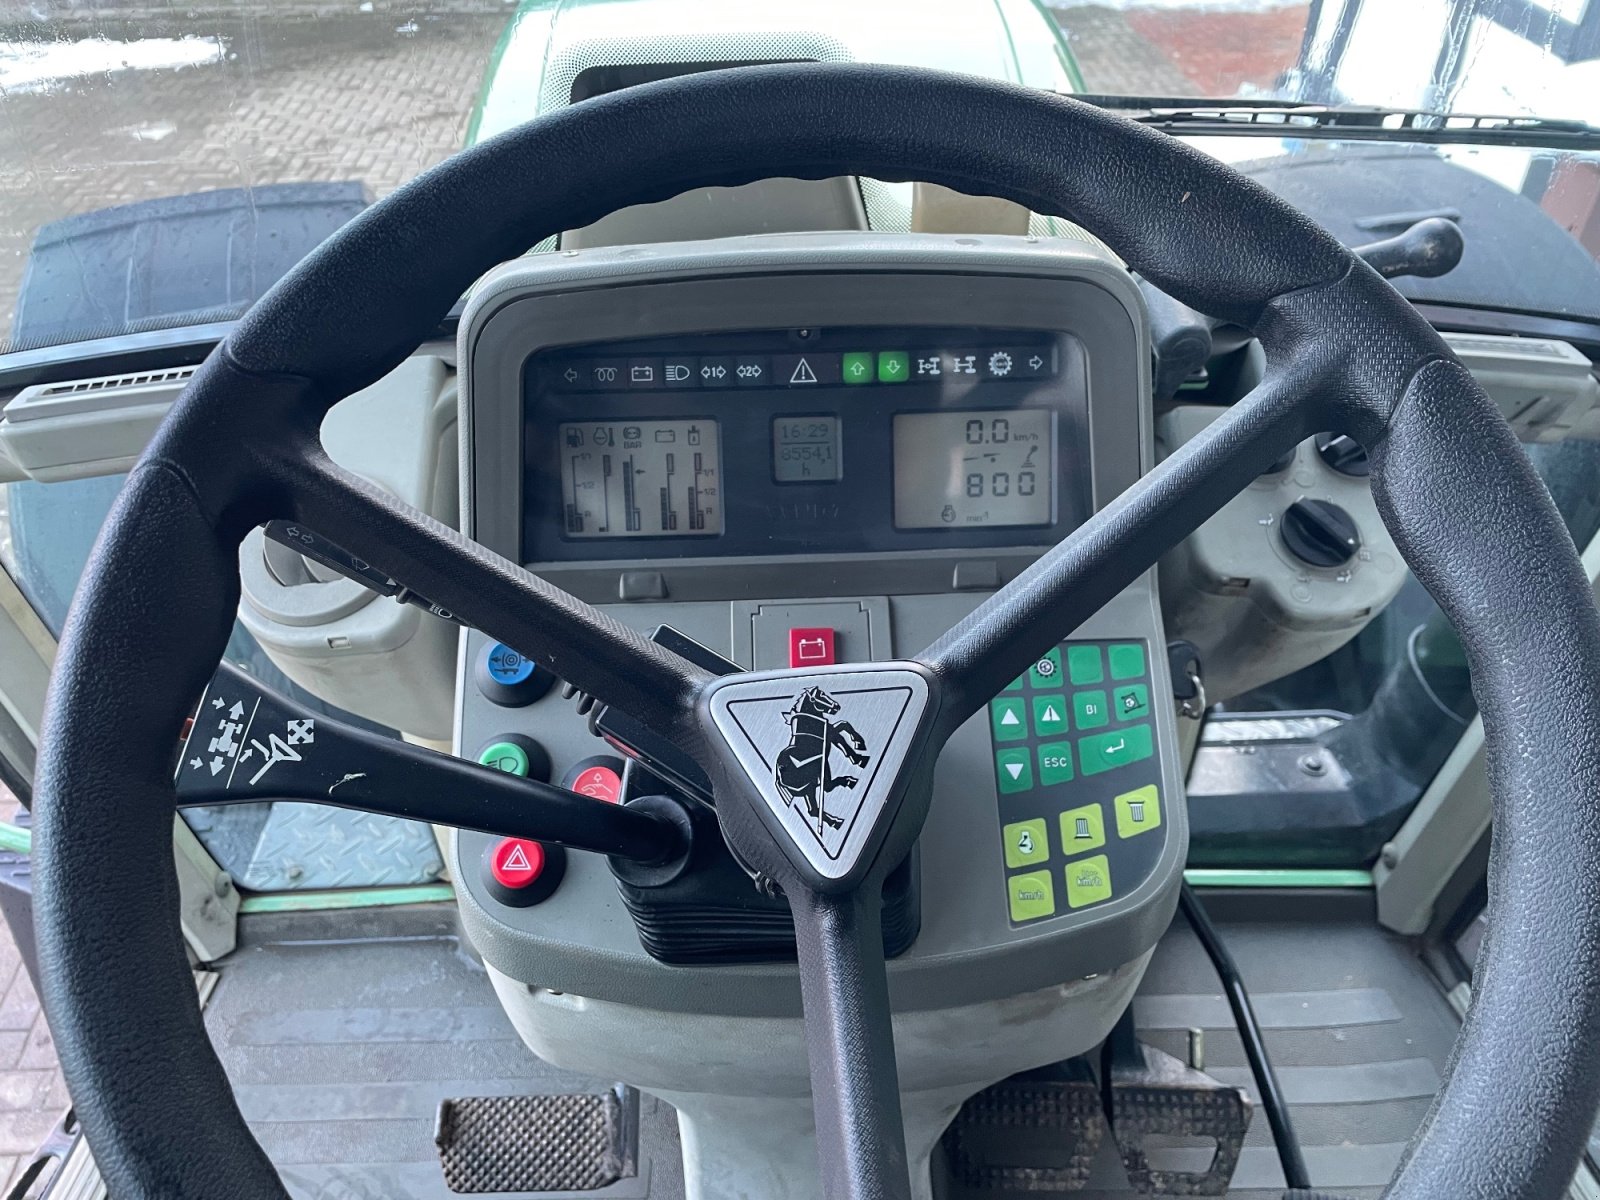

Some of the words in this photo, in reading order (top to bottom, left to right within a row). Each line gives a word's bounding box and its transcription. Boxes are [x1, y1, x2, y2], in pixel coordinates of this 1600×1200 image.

[781, 423, 829, 439] 16:29
[966, 418, 1009, 445] 0.0
[1013, 432, 1039, 442] km/h
[623, 440, 642, 449] BAR
[703, 468, 715, 477] 1/1
[801, 462, 811, 477] h
[966, 471, 1036, 498] 800
[703, 487, 716, 496] 1/2
[1086, 704, 1097, 715] BI
[1044, 757, 1067, 768] ESC
[1018, 889, 1045, 900] km/h
